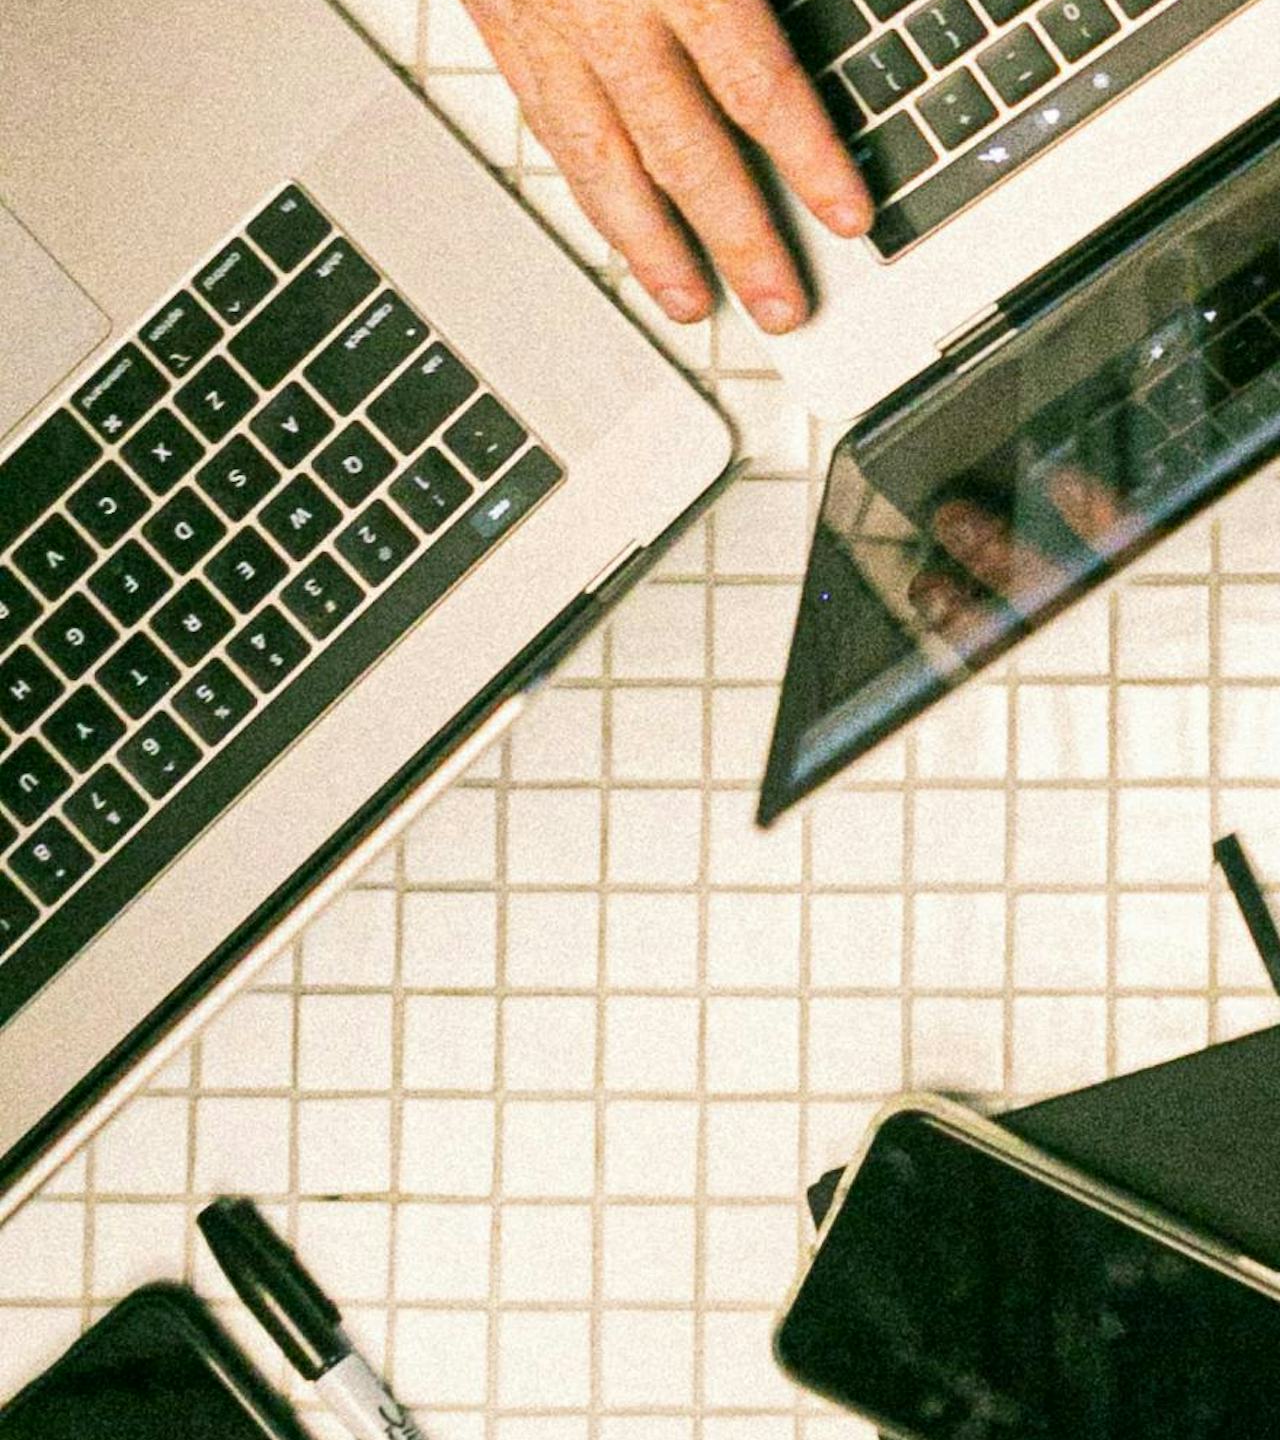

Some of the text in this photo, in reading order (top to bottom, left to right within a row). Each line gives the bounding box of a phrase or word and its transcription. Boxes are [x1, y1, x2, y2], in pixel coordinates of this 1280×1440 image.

[1061, 1, 1081, 21] 0
[204, 390, 225, 411] Z
[280, 415, 299, 433] A
[151, 442, 172, 462] X
[341, 455, 363, 474] Q
[227, 468, 247, 488] S
[413, 475, 430, 490] 1
[97, 496, 118, 515] C
[289, 507, 313, 530] W
[173, 520, 194, 541] D
[357, 525, 377, 544] 2
[45, 550, 65, 569] V
[235, 560, 256, 580] E
[124, 574, 139, 594] F
[303, 577, 323, 597] 3
[182, 613, 203, 632] R
[65, 626, 85, 646] G
[250, 633, 266, 650] 4
[130, 668, 148, 686] T
[10, 679, 31, 700] H
[195, 684, 215, 703] 5
[76, 722, 94, 739] Y
[141, 737, 160, 756] 6
[18, 772, 39, 793] U
[91, 792, 106, 810] 7
